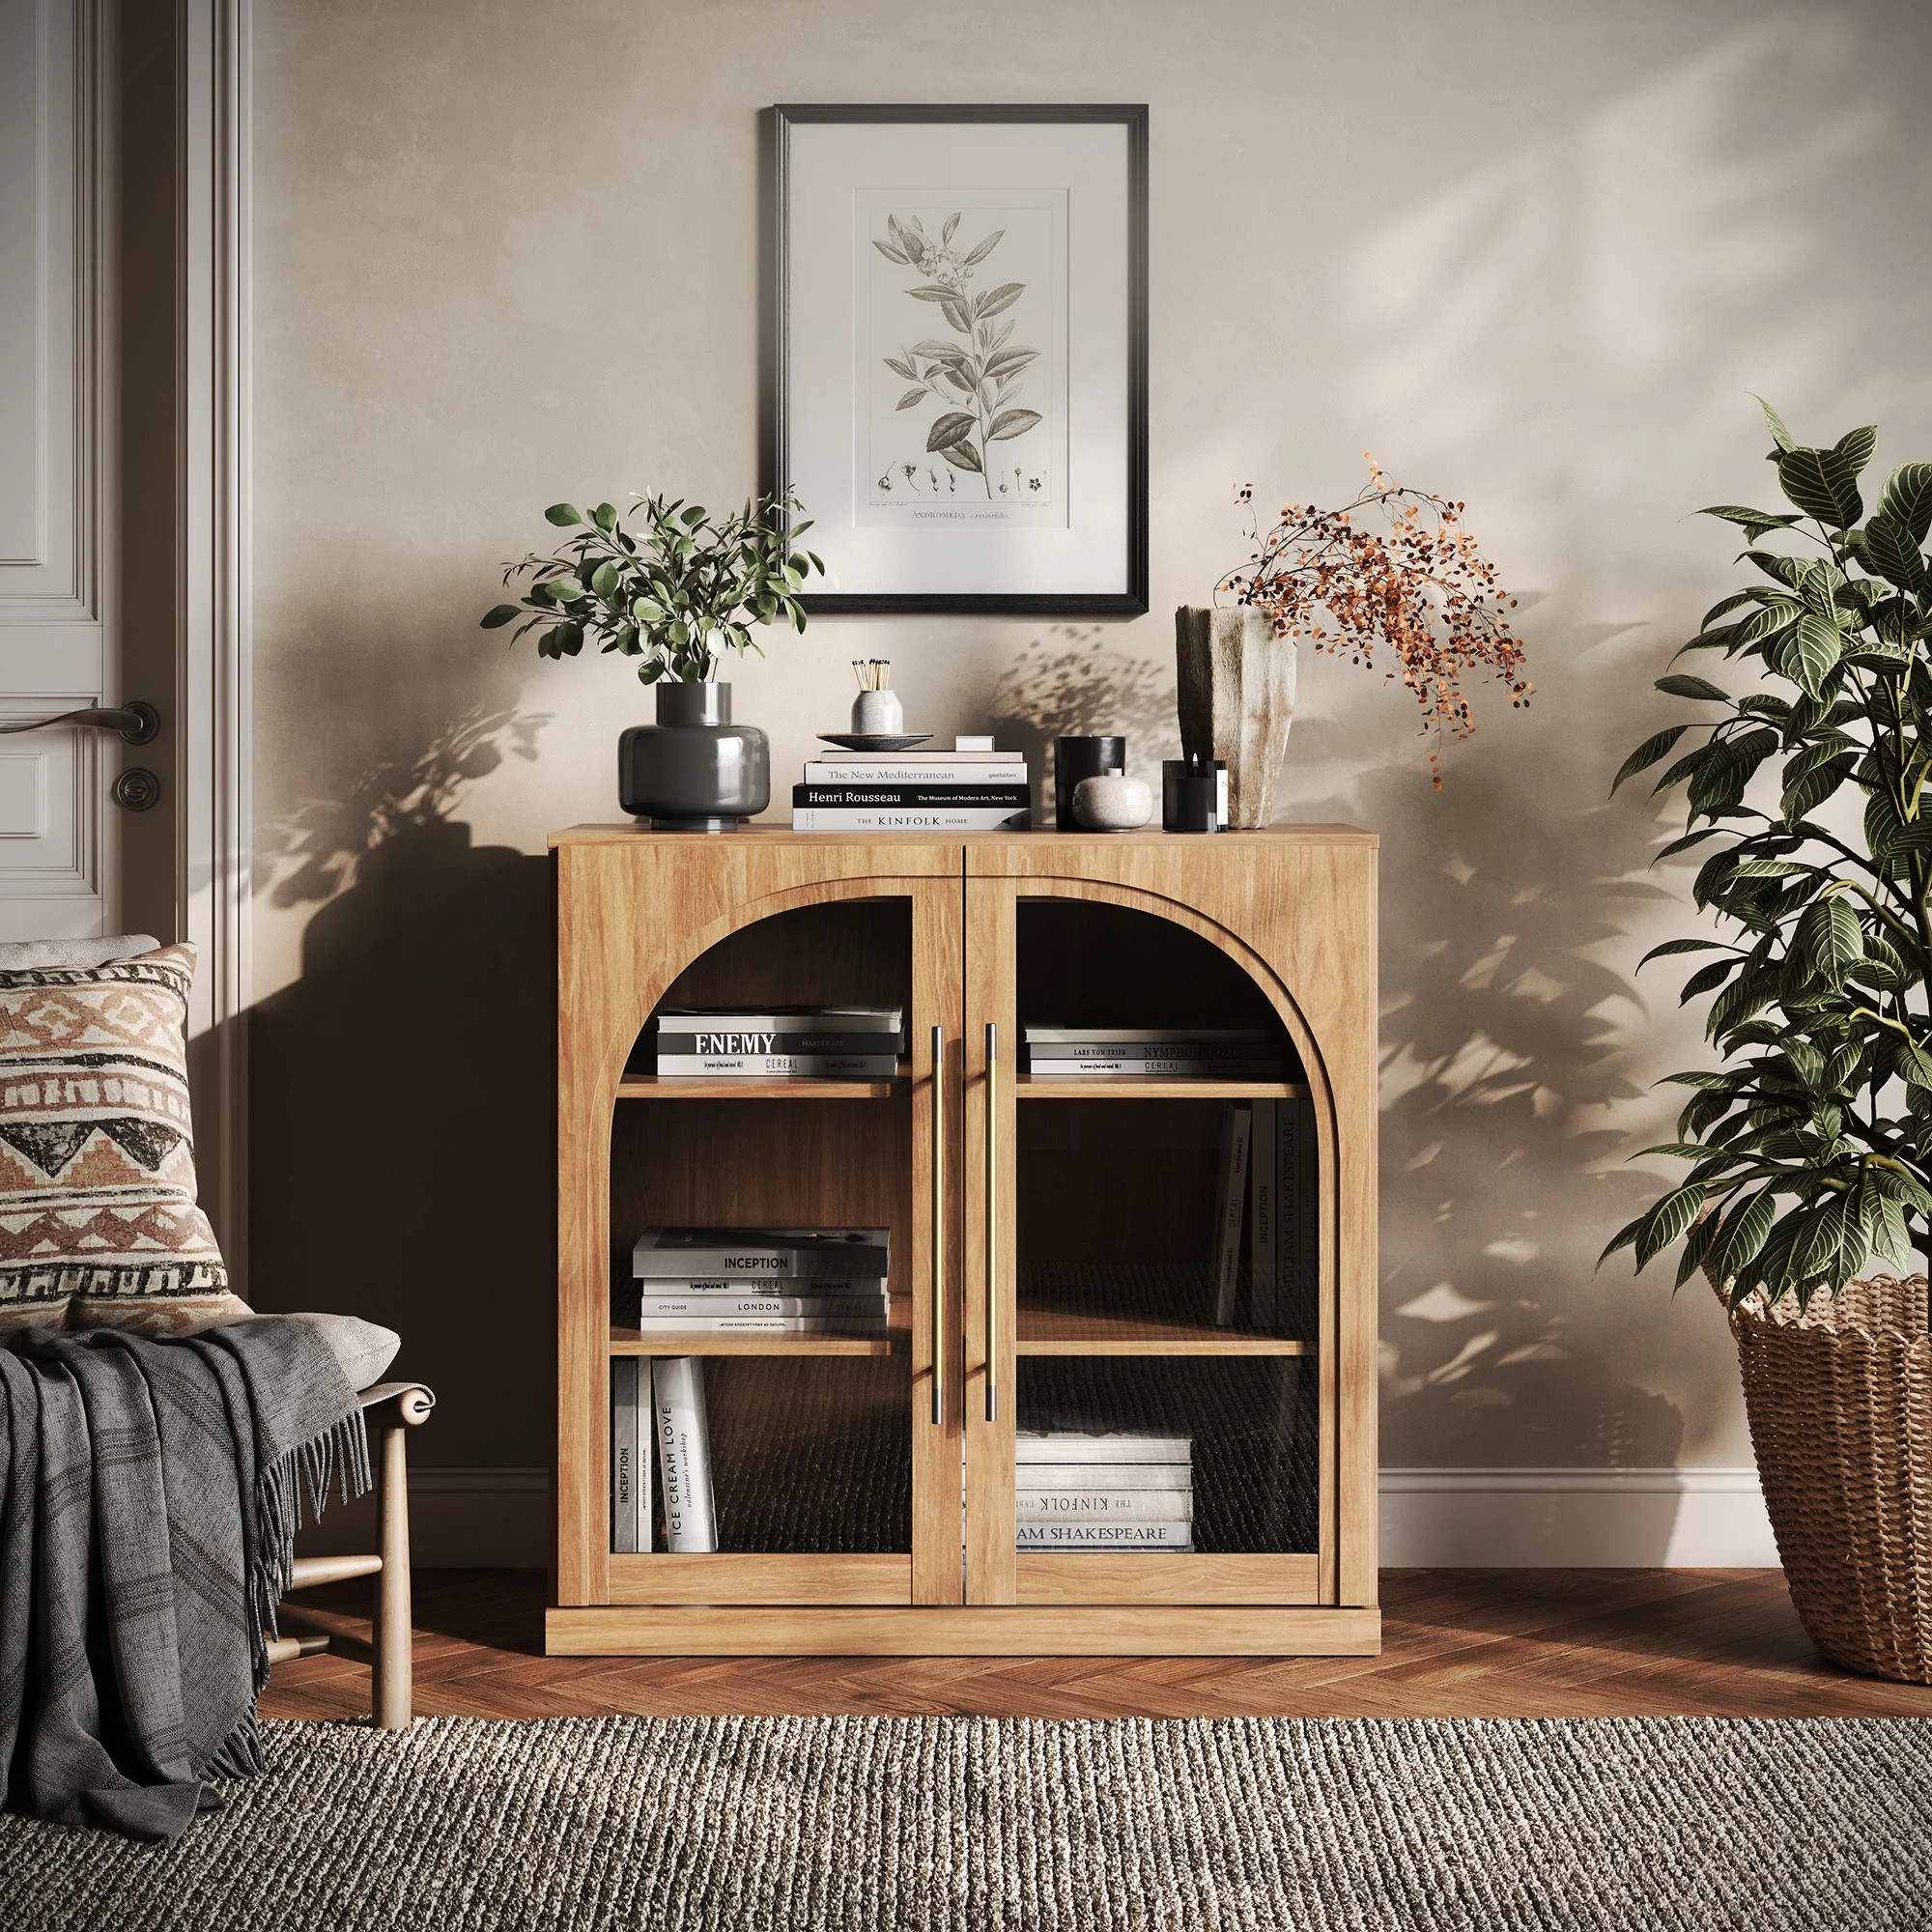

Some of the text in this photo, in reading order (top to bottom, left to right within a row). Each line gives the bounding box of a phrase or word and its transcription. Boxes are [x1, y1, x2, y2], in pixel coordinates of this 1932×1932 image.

[912, 510, 966, 519] ANDROMEDA
[828, 770, 954, 780] The New Mediterranean
[809, 791, 901, 803] Henri Rousseau
[878, 817, 941, 826] KINFOLK
[695, 1034, 777, 1054] ENEMY
[765, 1059, 799, 1069] CEREAL
[1283, 1118, 1294, 1224] SHAKESPEARE
[1260, 1185, 1268, 1243] INCEPTION
[724, 1258, 788, 1268] INCEPTION
[751, 1280, 784, 1290] CEREAL
[680, 1433, 689, 1467] workshop
[619, 1447, 629, 1503] INCEPTION
[662, 1407, 682, 1536] ICE CREAM LOVE
[1039, 1497, 1109, 1511] KINFOLK
[1115, 1499, 1132, 1508] THE
[1050, 1527, 1167, 1540] SHAKESPEARE
